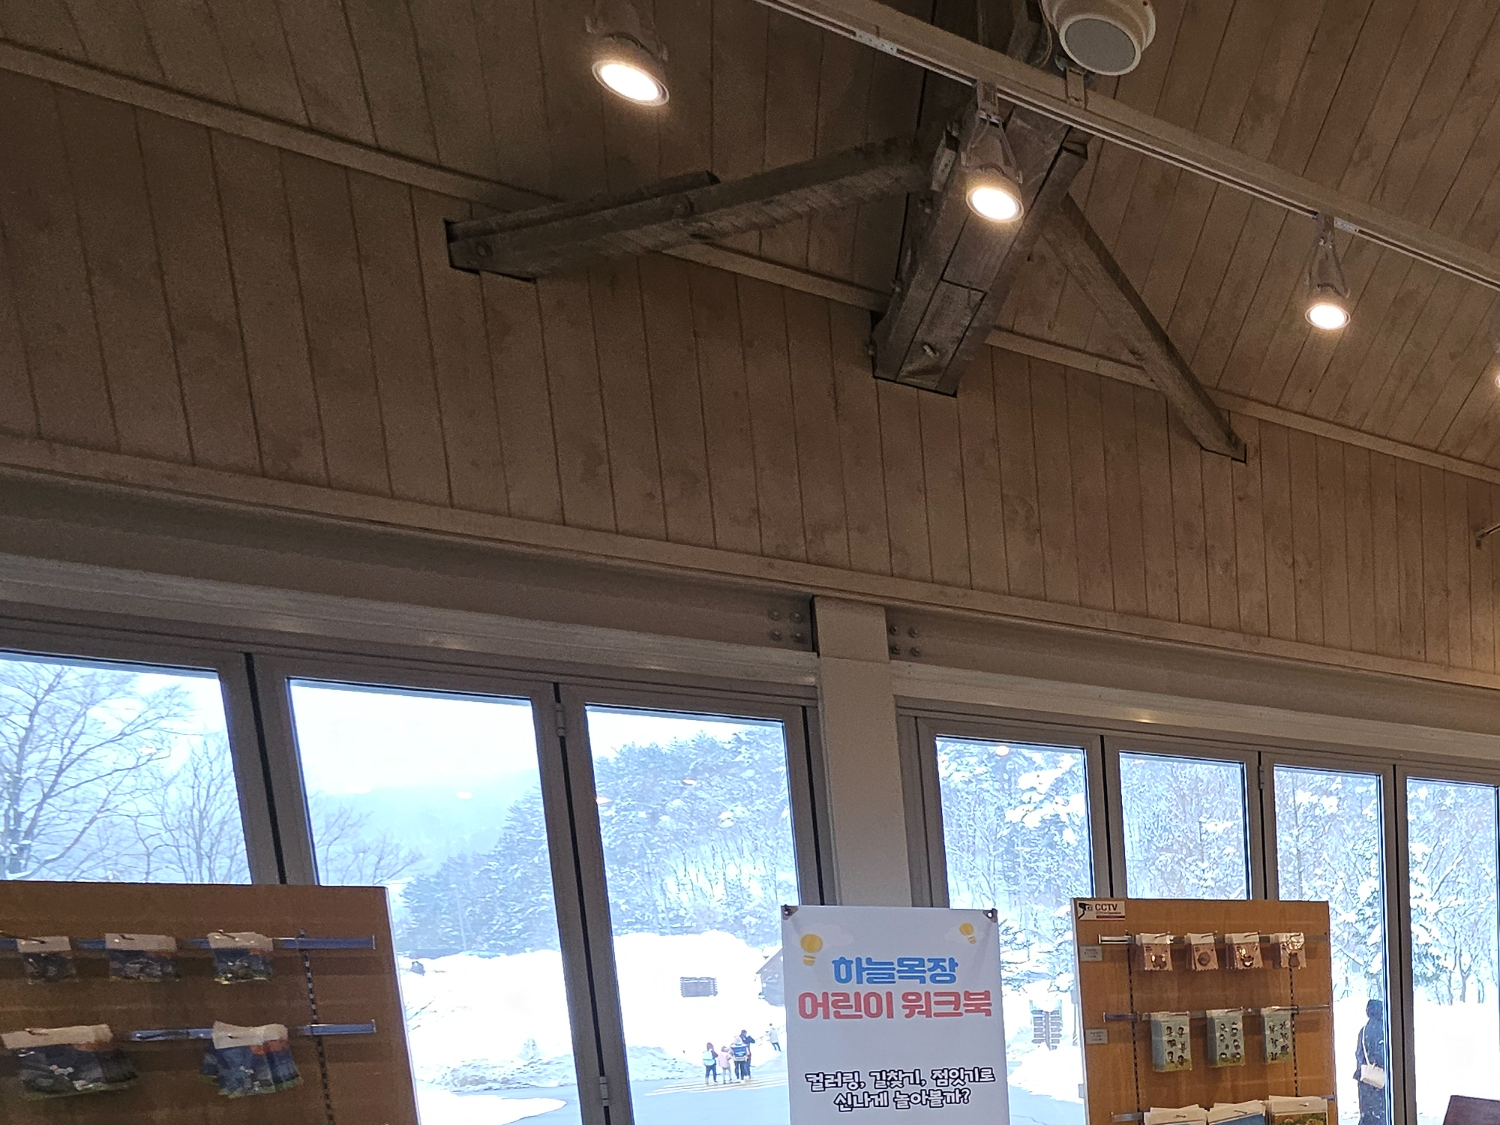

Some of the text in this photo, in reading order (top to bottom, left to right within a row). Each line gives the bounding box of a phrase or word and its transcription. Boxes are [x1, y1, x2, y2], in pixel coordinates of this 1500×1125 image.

[1095, 903, 1118, 911] CCTV
[832, 956, 959, 985] 하늘목장
[798, 990, 992, 1020] 어린이 워크북
[805, 1067, 996, 1092] 컬러링, 길찾기, 점잇기로
[833, 1088, 972, 1112] 신나게 놀아볼까?
